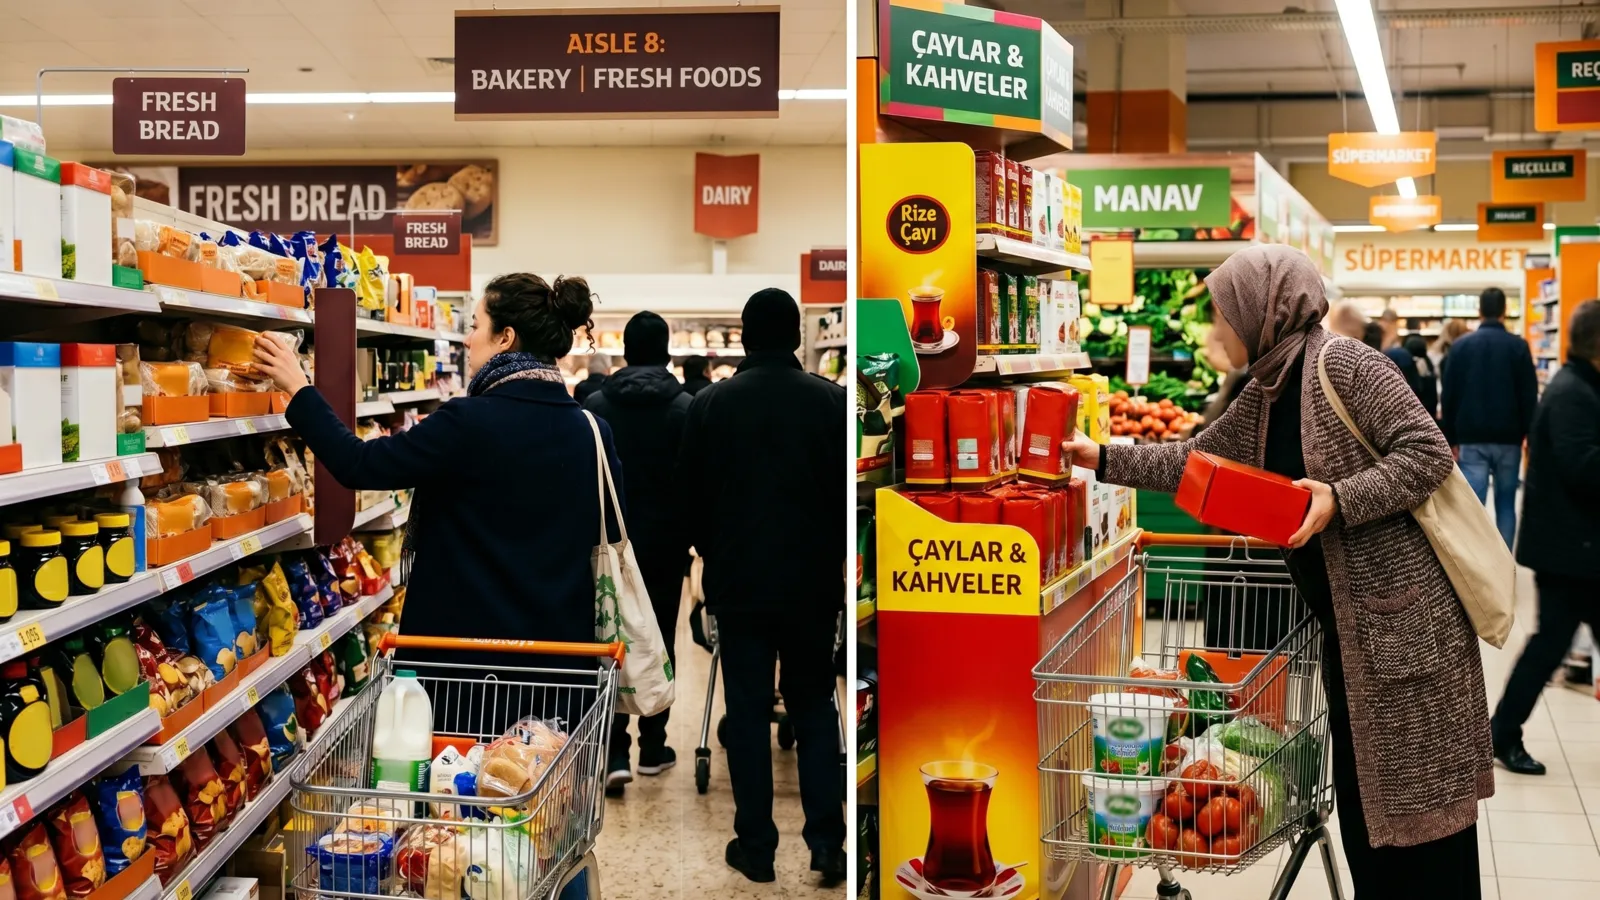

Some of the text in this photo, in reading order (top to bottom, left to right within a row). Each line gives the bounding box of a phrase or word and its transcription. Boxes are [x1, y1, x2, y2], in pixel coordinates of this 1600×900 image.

[566, 32, 665, 54] AISLE 8:
[911, 29, 1024, 68] ÇAYLAR &
[471, 66, 762, 90] BAKERY FRESH FOODS
[906, 62, 1028, 100] KAHVELER
[142, 91, 217, 112] FRESH
[138, 119, 220, 140] BREAD
[1332, 147, 1432, 164] SÜPERMARKET
[1511, 161, 1567, 175] REÇELLER
[189, 184, 387, 222] FRESH BREAD
[702, 185, 752, 205] DAIRY
[1094, 183, 1203, 213] MANAV
[901, 204, 937, 222] Rize
[406, 222, 447, 234] FRESH
[900, 224, 937, 246] Çayı
[404, 236, 449, 249] BREAD
[1345, 244, 1529, 271] SÜPERMARKET
[908, 538, 1026, 567] ÇAYLAR &
[892, 570, 1023, 596] KAHVELER
